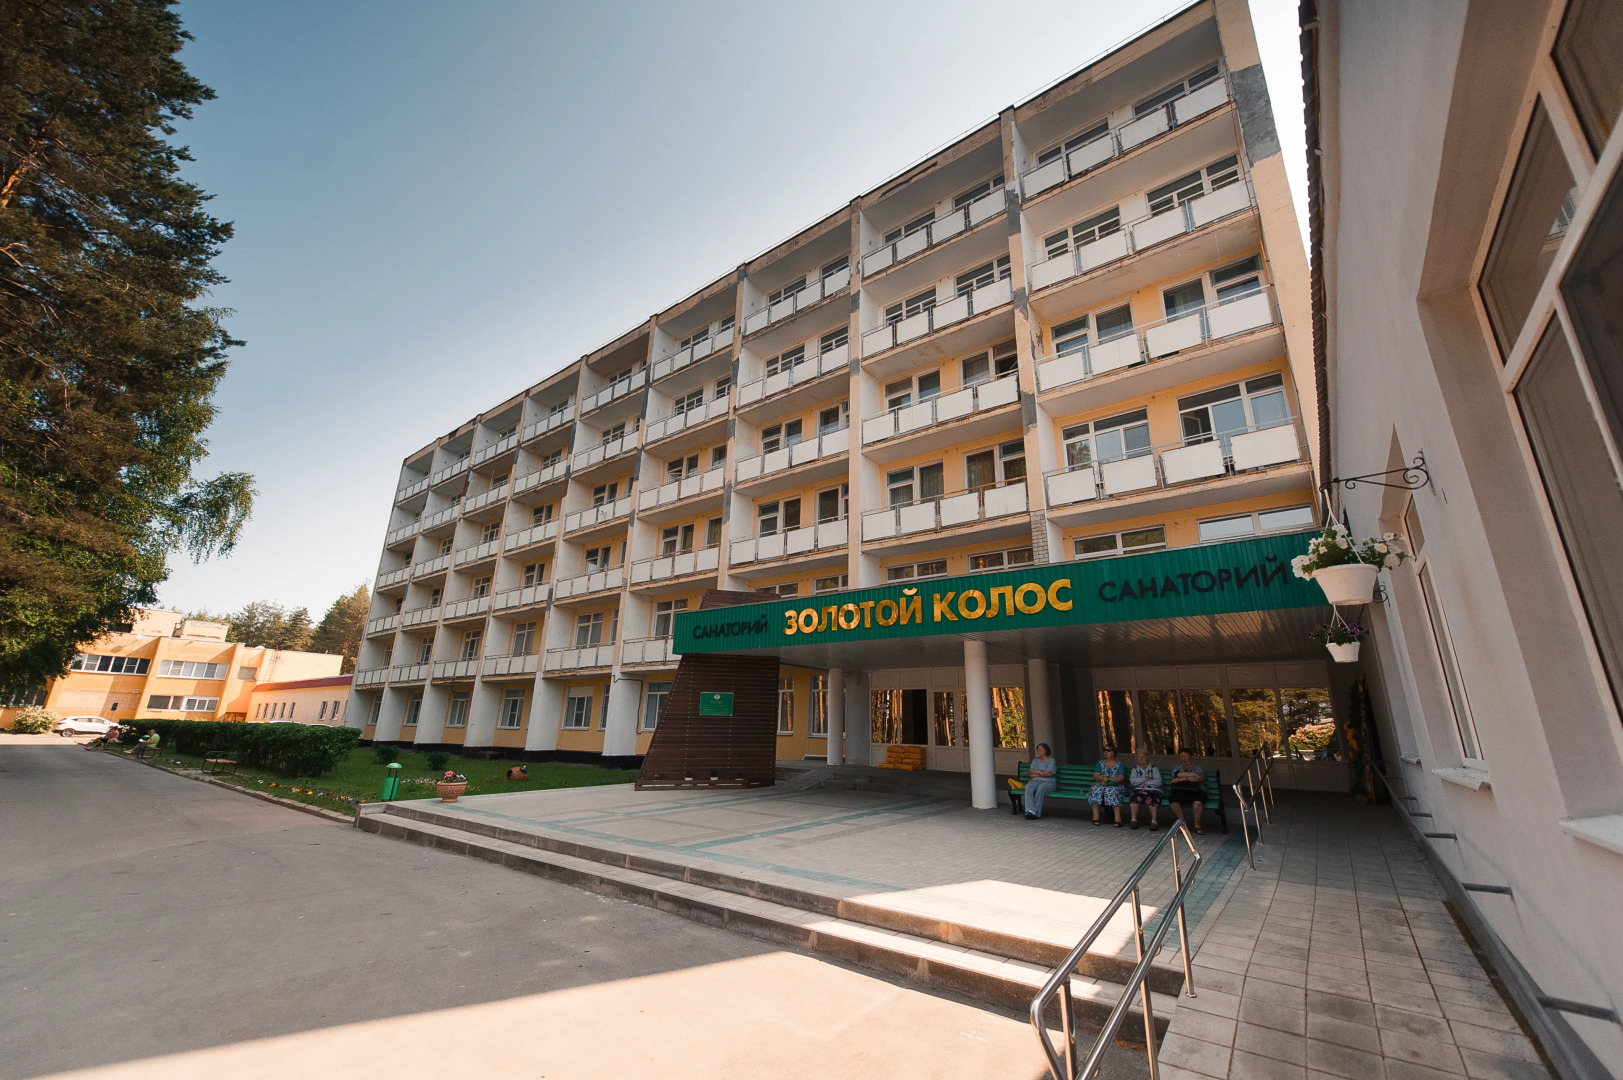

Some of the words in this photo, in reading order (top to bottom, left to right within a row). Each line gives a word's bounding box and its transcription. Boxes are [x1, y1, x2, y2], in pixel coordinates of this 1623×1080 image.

[693, 614, 768, 639] САНАТОРИЙ
[783, 587, 923, 635] ЗОЛОТОЙ
[933, 578, 1073, 623] КОЛОС
[1098, 555, 1289, 602] САНАТОРИЙ
